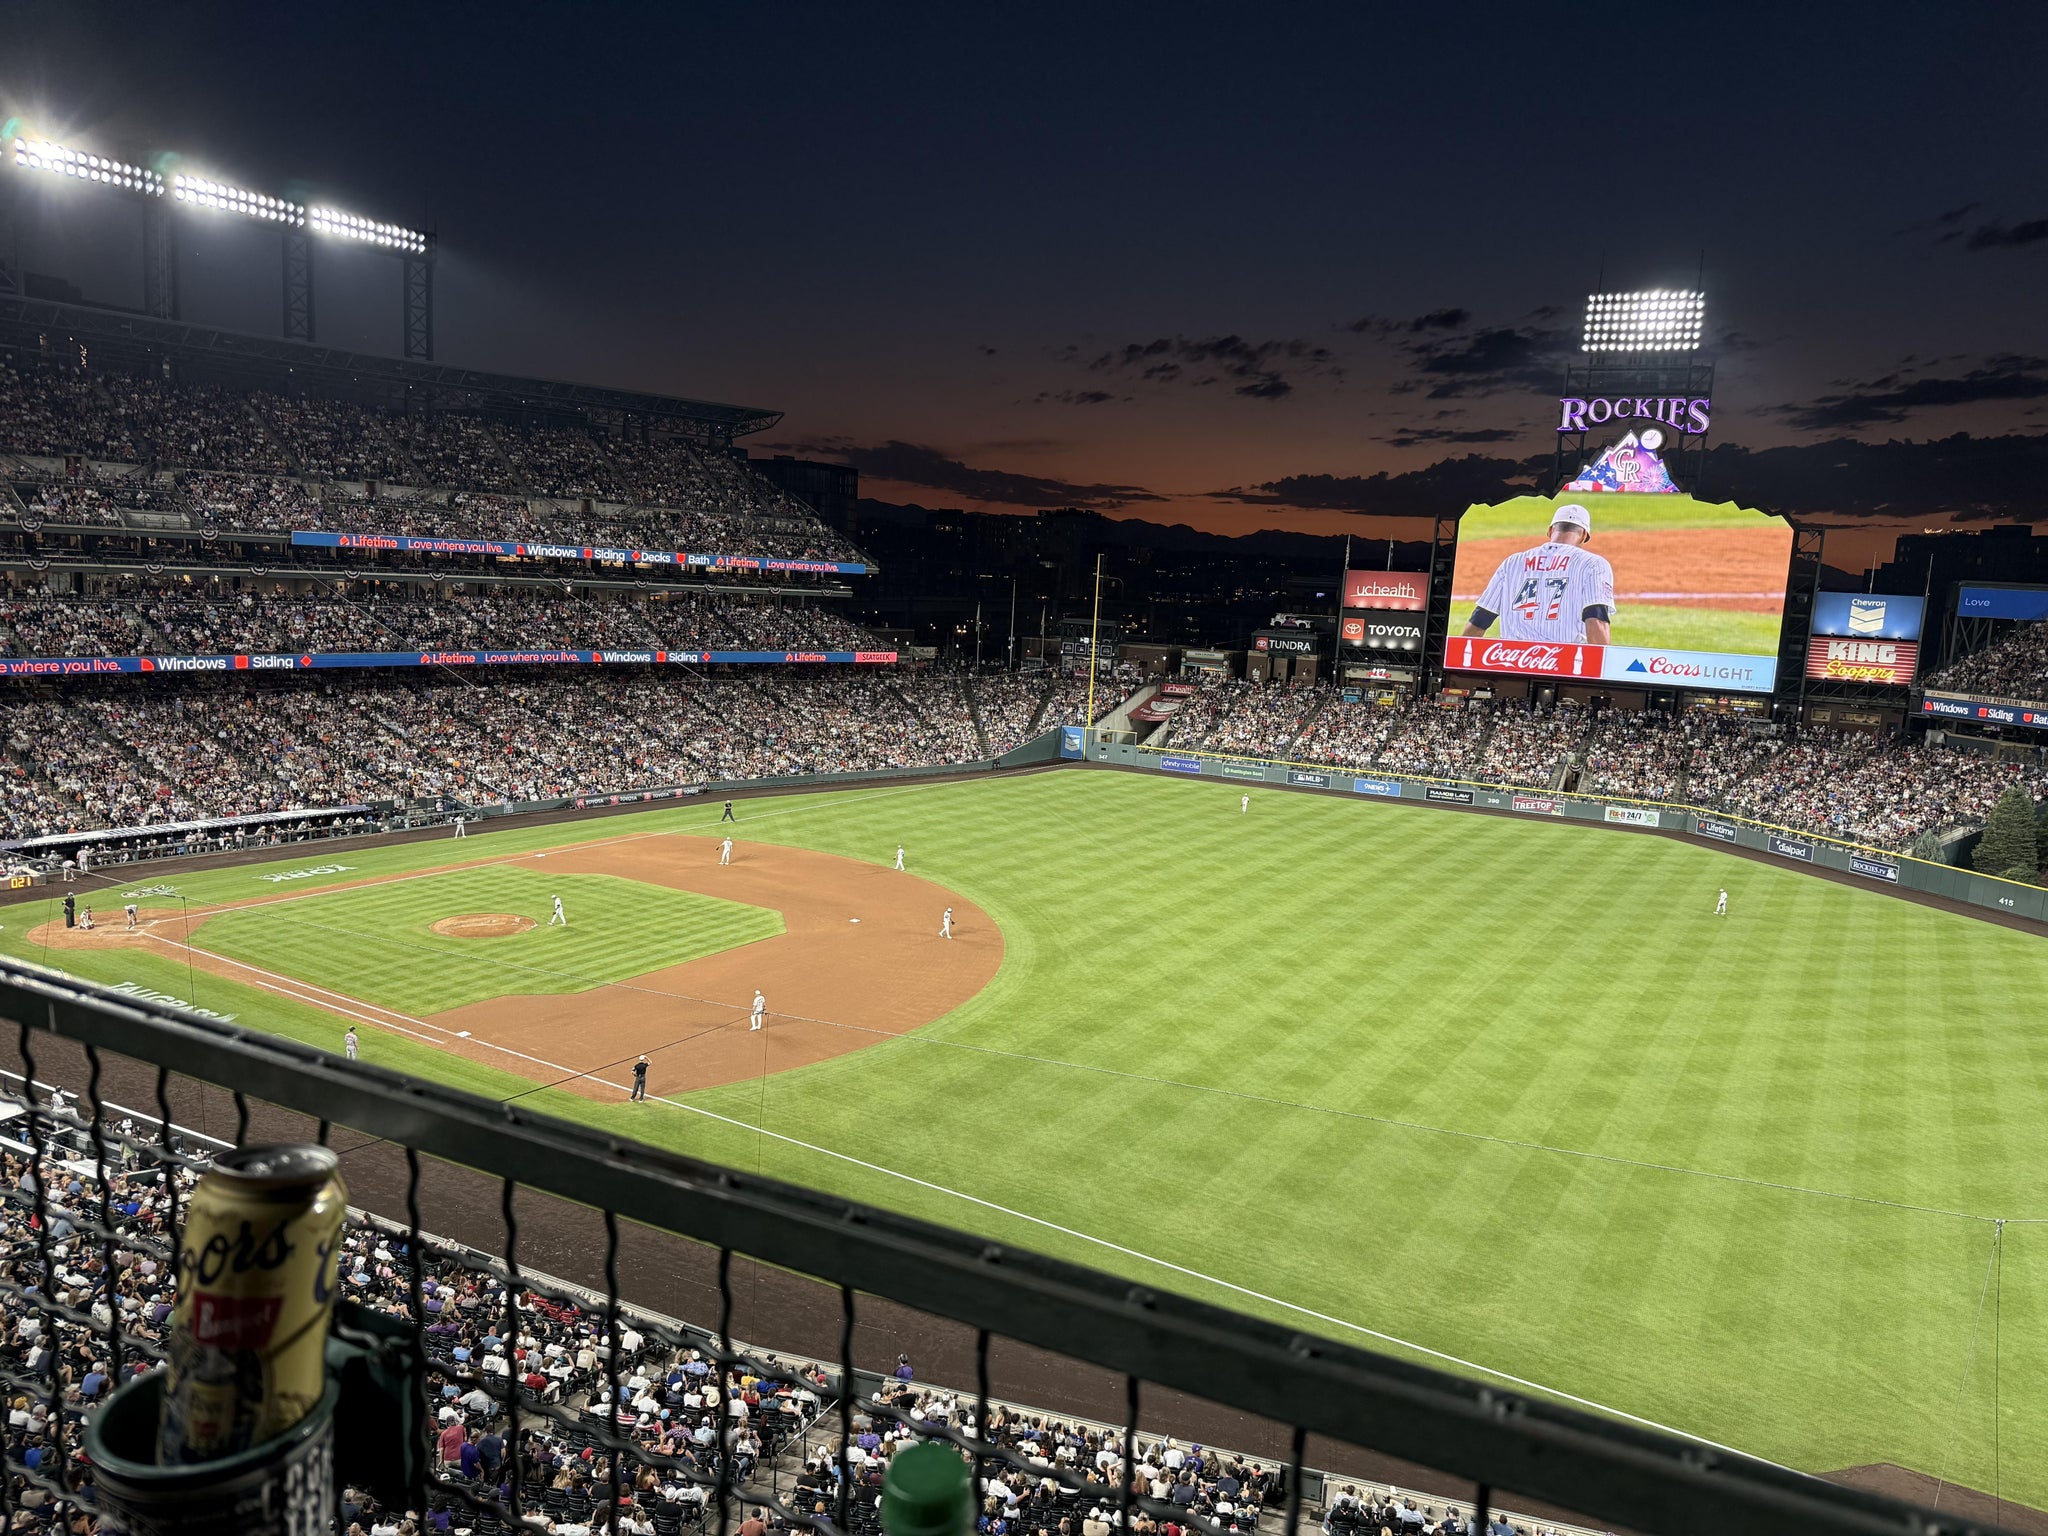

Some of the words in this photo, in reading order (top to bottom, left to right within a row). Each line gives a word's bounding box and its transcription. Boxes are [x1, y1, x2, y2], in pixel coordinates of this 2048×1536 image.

[1556, 398, 1710, 433] ROCKIES
[352, 535, 398, 548] Lifetime
[408, 539, 433, 550] Love
[434, 540, 466, 551] where
[467, 543, 485, 554] you
[486, 541, 505, 553] live.
[527, 545, 577, 558] Windows
[594, 549, 625, 562] Siding
[641, 552, 671, 563] Decks
[688, 555, 710, 565] Bath
[726, 557, 760, 568] Lifetime
[766, 559, 785, 569] Love
[785, 560, 810, 571] where
[810, 563, 825, 573] you
[1524, 555, 1570, 572] MEJIA
[1356, 581, 1415, 598] uchealth
[1512, 577, 1569, 620] 47
[1851, 598, 1886, 607] Chevron
[1965, 598, 1990, 606] Love
[1368, 624, 1421, 637] TOYOTA
[1269, 639, 1311, 651] TUNDRA
[432, 653, 476, 663] Lifetime
[485, 652, 508, 662] Love
[509, 652, 539, 662] where
[540, 653, 560, 664] you
[561, 652, 580, 662] live.
[603, 651, 651, 662] Windows
[668, 652, 698, 663] Siding
[794, 653, 827, 662] Lifetime
[1482, 642, 1564, 671] Coca-Cola
[1827, 642, 1897, 664] KING
[10, 659, 60, 673] where
[62, 661, 92, 674] you
[93, 659, 122, 671] live.
[157, 656, 227, 670] Windows
[252, 655, 294, 669] Siding
[1650, 656, 1701, 677] Coors
[1703, 665, 1753, 681] LIGHT
[1826, 660, 1896, 680] Soopers
[1164, 684, 1194, 695] uchealth
[1932, 701, 1969, 715] Windows
[1987, 708, 2014, 722] Siding
[2032, 714, 2048, 725] Bat
[1181, 761, 1200, 770] mobile
[1626, 811, 1642, 820] 24/7
[1706, 823, 1734, 836] Lifetime
[1778, 844, 1806, 857] dialpad
[1998, 897, 2014, 906] 415
